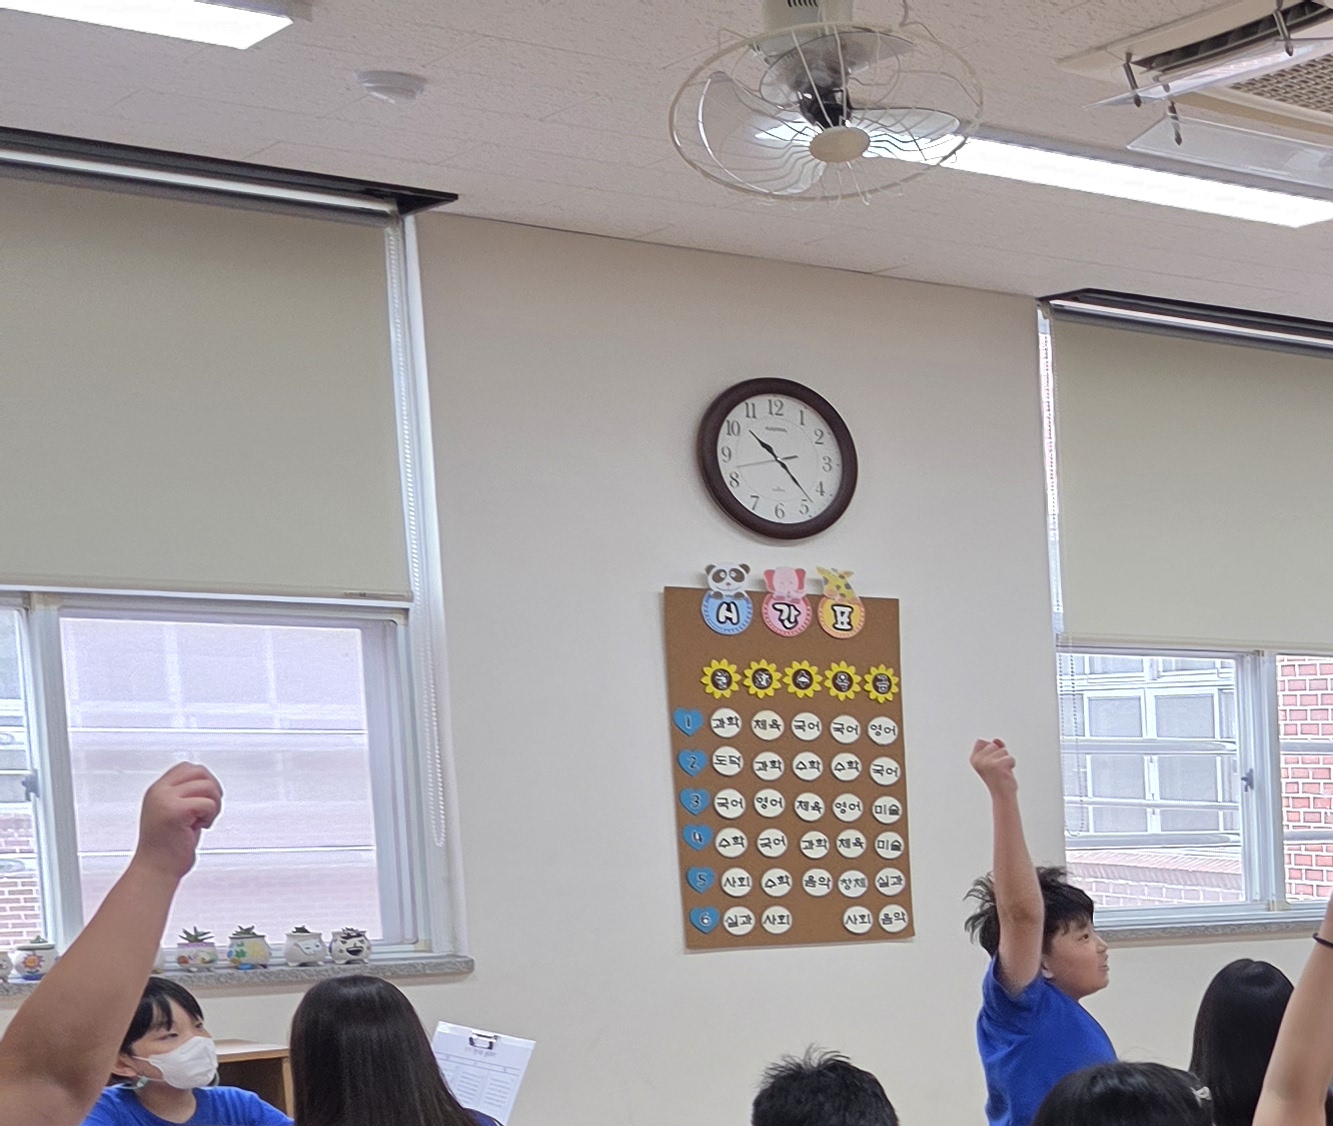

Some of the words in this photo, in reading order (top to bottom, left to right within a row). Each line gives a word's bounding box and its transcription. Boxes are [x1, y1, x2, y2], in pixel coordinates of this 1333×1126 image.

[744, 401, 757, 419] 11
[768, 399, 785, 416] 12
[800, 409, 806, 426] 1
[726, 419, 741, 436] 10
[814, 428, 825, 445] 2
[721, 446, 732, 463] 9
[822, 456, 833, 472] 3
[729, 471, 740, 488] 8
[815, 481, 826, 496] 4
[750, 495, 760, 511] 7
[774, 503, 785, 519] 6
[799, 499, 810, 515] 5
[712, 716, 740, 729] 과학
[753, 719, 782, 731] 체육
[794, 719, 820, 732] 국어
[832, 721, 859, 735] 국어
[869, 724, 897, 737] 영어
[714, 753, 742, 769] 도덕
[755, 758, 782, 773] 과학
[795, 758, 821, 772] 수학
[834, 758, 860, 772] 수학
[872, 763, 898, 778] 국어
[716, 796, 744, 810] 국어
[756, 796, 783, 810] 영어
[796, 799, 823, 815] 체육
[835, 801, 861, 815] 영어
[874, 804, 900, 816] 미술
[718, 835, 745, 850] 수학
[759, 836, 786, 850] 국어
[801, 837, 828, 851] 과학
[838, 836, 865, 850] 체육
[877, 838, 903, 852] 미술
[723, 874, 750, 888] 사회
[764, 874, 791, 889] 수학
[804, 875, 831, 889] 음악
[839, 877, 866, 891] 창체
[877, 874, 903, 888] 실과
[725, 913, 753, 928] 실과
[762, 913, 790, 926] 사회
[845, 912, 871, 925] 사회
[881, 911, 907, 925] 음악
